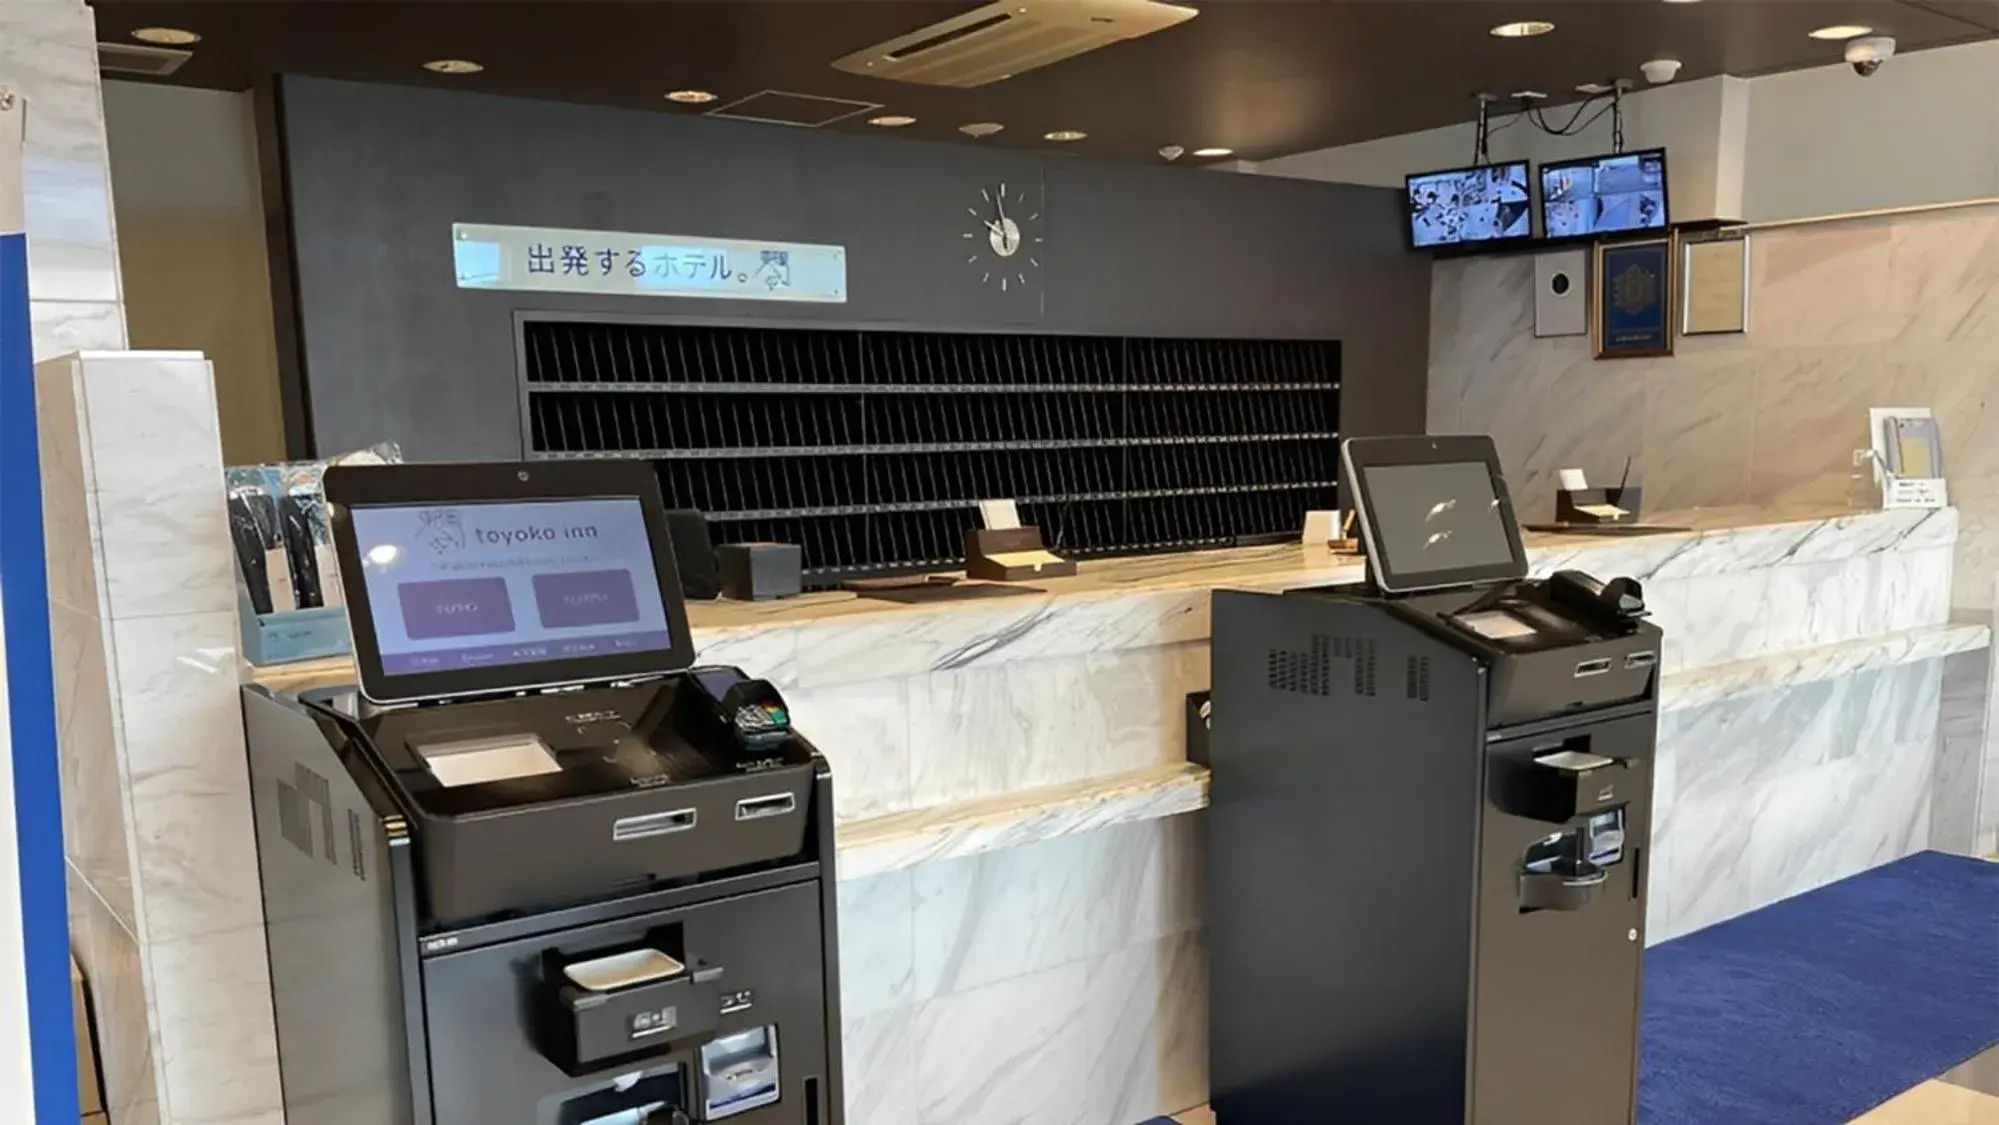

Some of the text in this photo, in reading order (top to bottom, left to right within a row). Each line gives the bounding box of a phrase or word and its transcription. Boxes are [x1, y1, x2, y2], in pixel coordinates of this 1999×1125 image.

[527, 243, 748, 284] 出発するホテル。
[475, 523, 598, 547] toyoko inn
